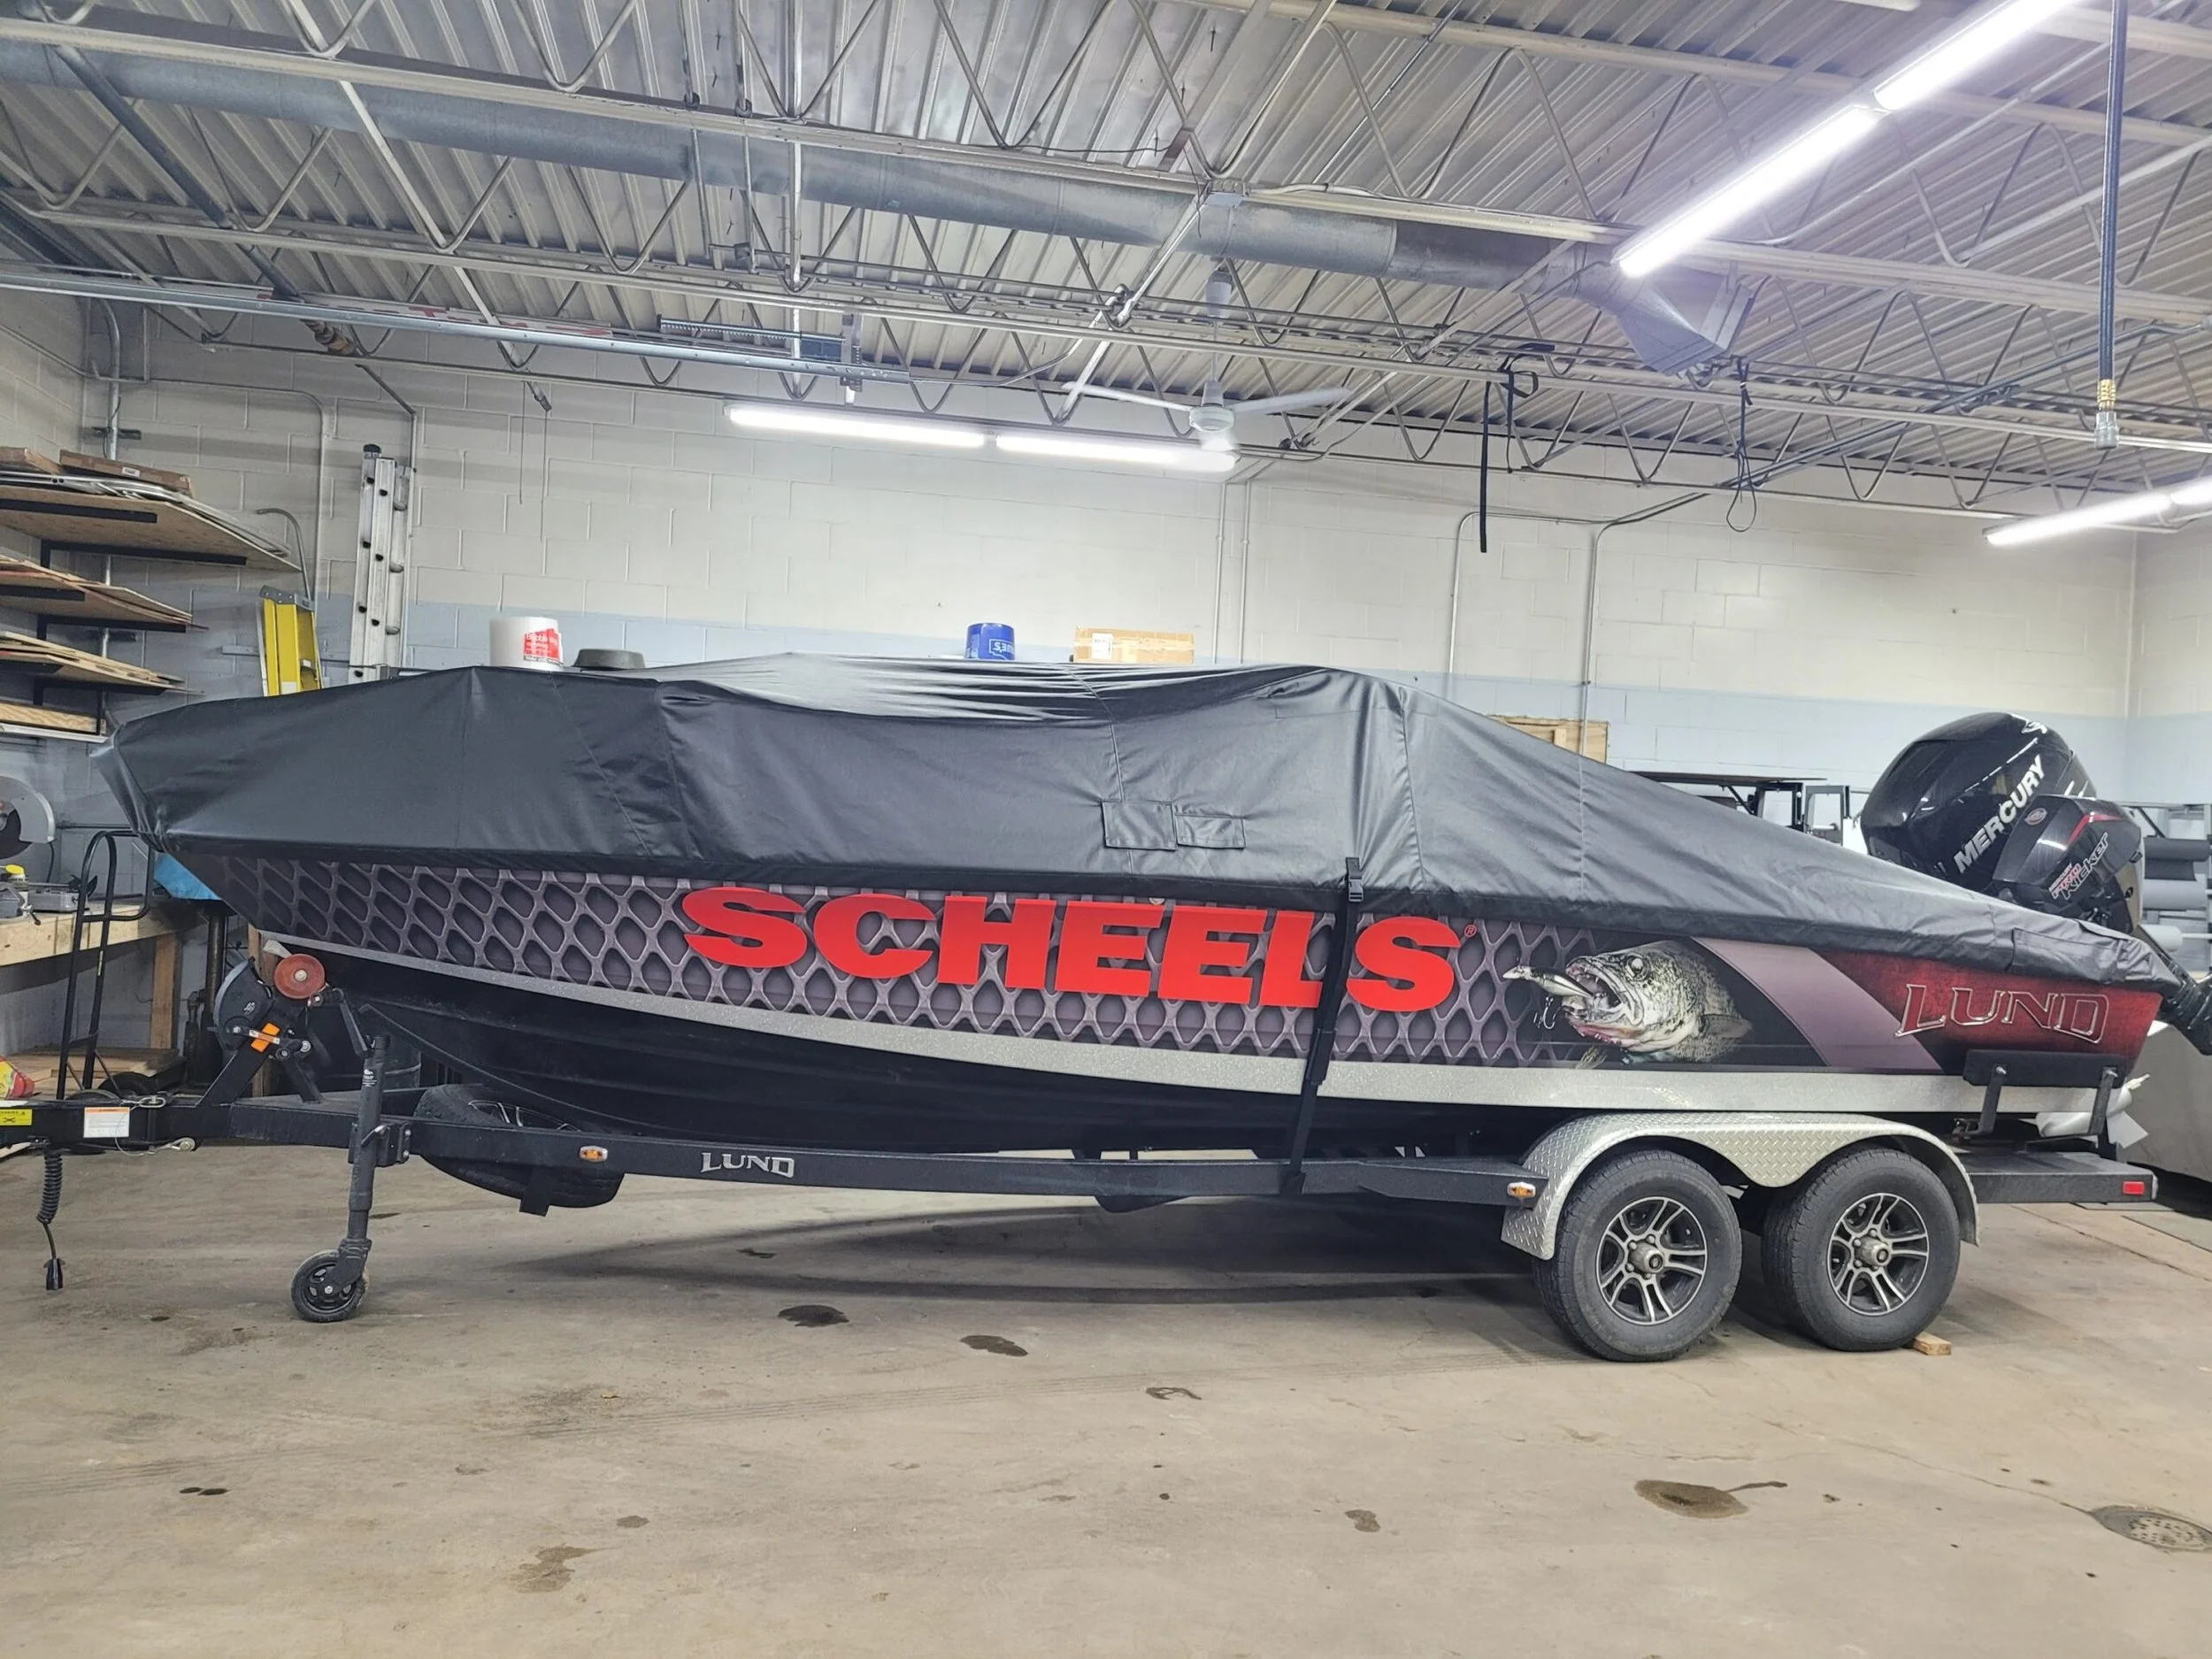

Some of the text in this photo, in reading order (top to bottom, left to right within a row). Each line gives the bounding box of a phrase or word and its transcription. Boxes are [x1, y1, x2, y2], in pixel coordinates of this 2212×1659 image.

[1954, 754, 2045, 874] MERCURY
[682, 887, 1459, 1011] SCHEELS
[1895, 984, 2109, 1043] LUND
[701, 1152, 795, 1178] LUND
